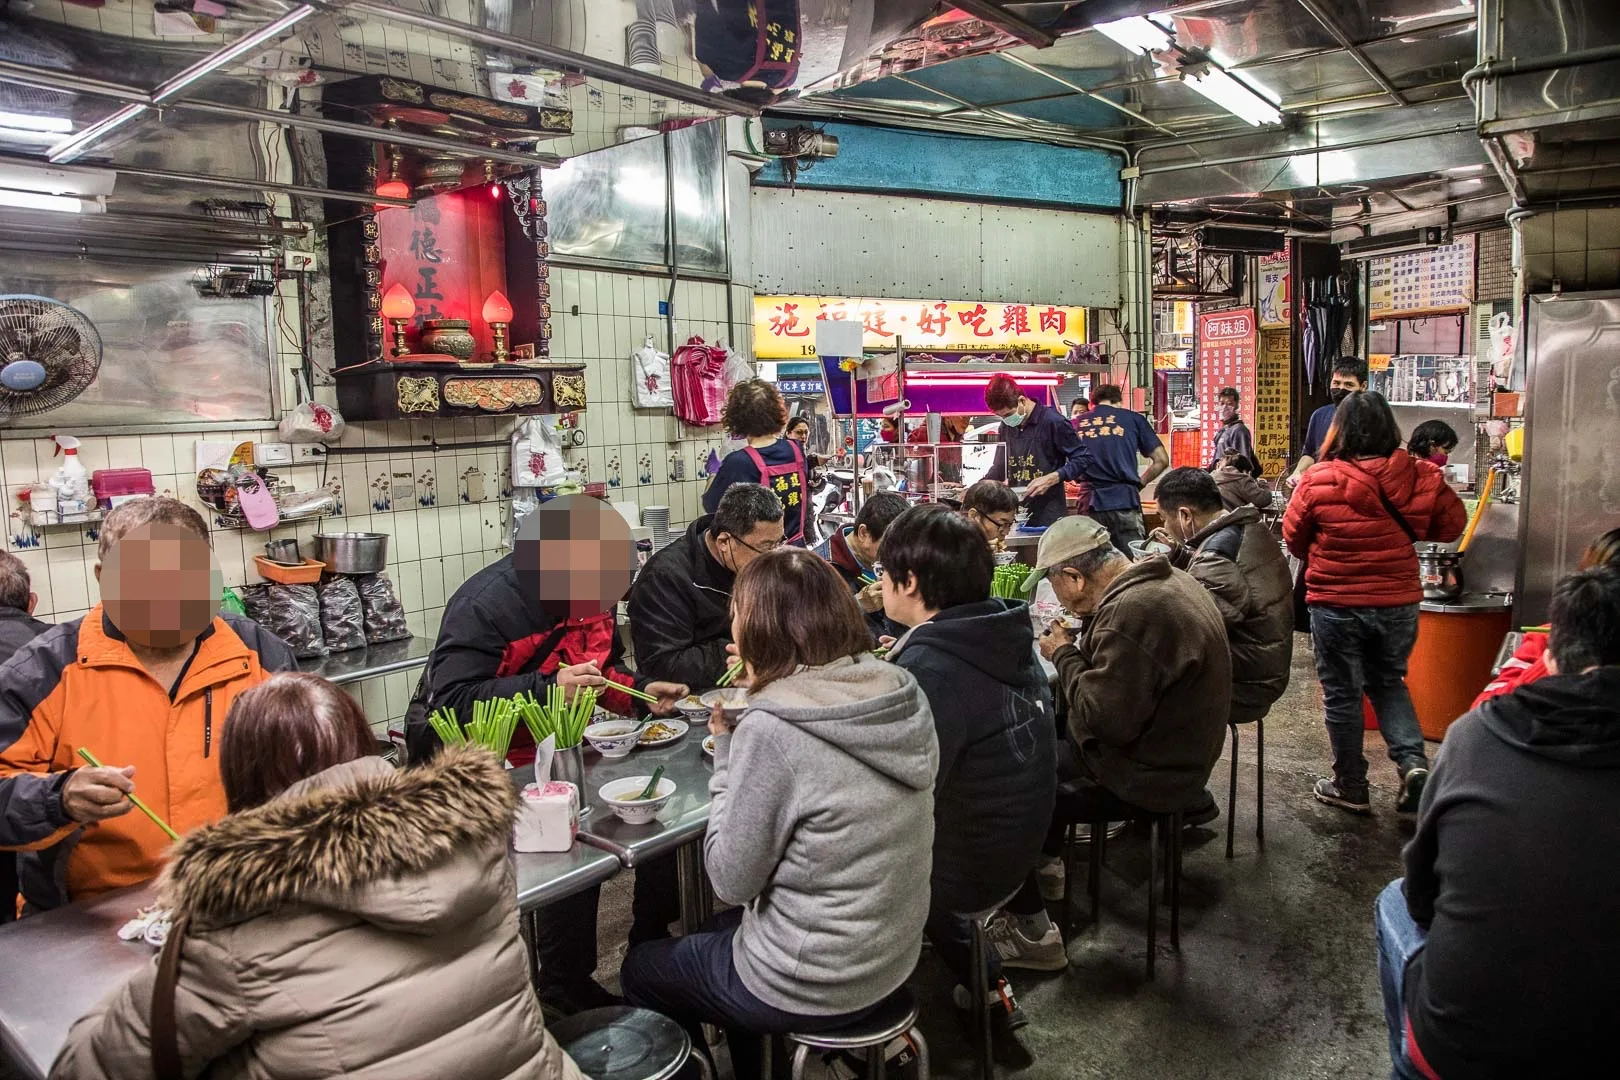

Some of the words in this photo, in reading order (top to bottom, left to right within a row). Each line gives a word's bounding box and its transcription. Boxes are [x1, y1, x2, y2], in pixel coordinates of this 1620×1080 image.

[1207, 318, 1247, 337] 阿妹姐
[771, 473, 801, 492] 福建
[1008, 468, 1044, 481] 吃雞肉
